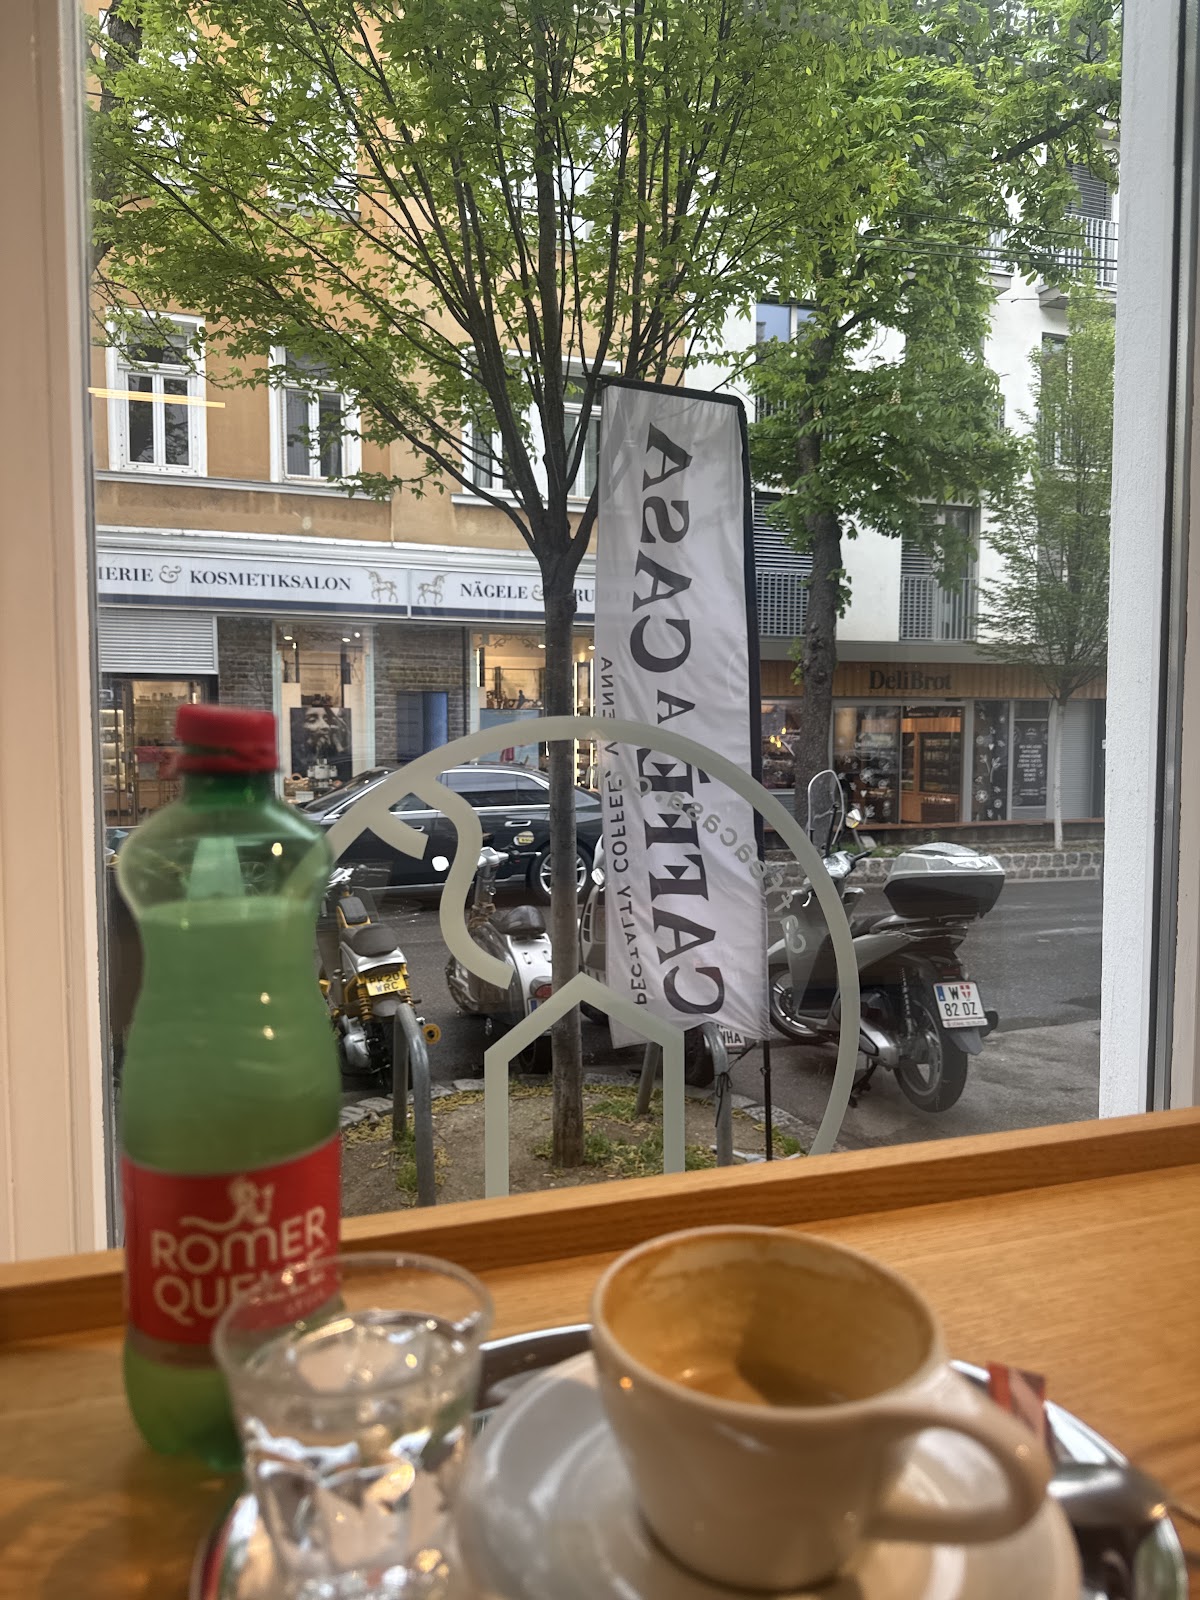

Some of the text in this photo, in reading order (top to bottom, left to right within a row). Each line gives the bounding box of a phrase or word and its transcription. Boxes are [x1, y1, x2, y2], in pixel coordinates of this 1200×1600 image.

[159, 564, 182, 584] &
[189, 570, 352, 592] KOSMETIKSALON
[460, 581, 528, 600] NÄGELE
[868, 670, 953, 690] DeliBrot
[376, 981, 399, 993] WRC
[948, 986, 959, 1000] W
[944, 1002, 978, 1017] 82 DZ
